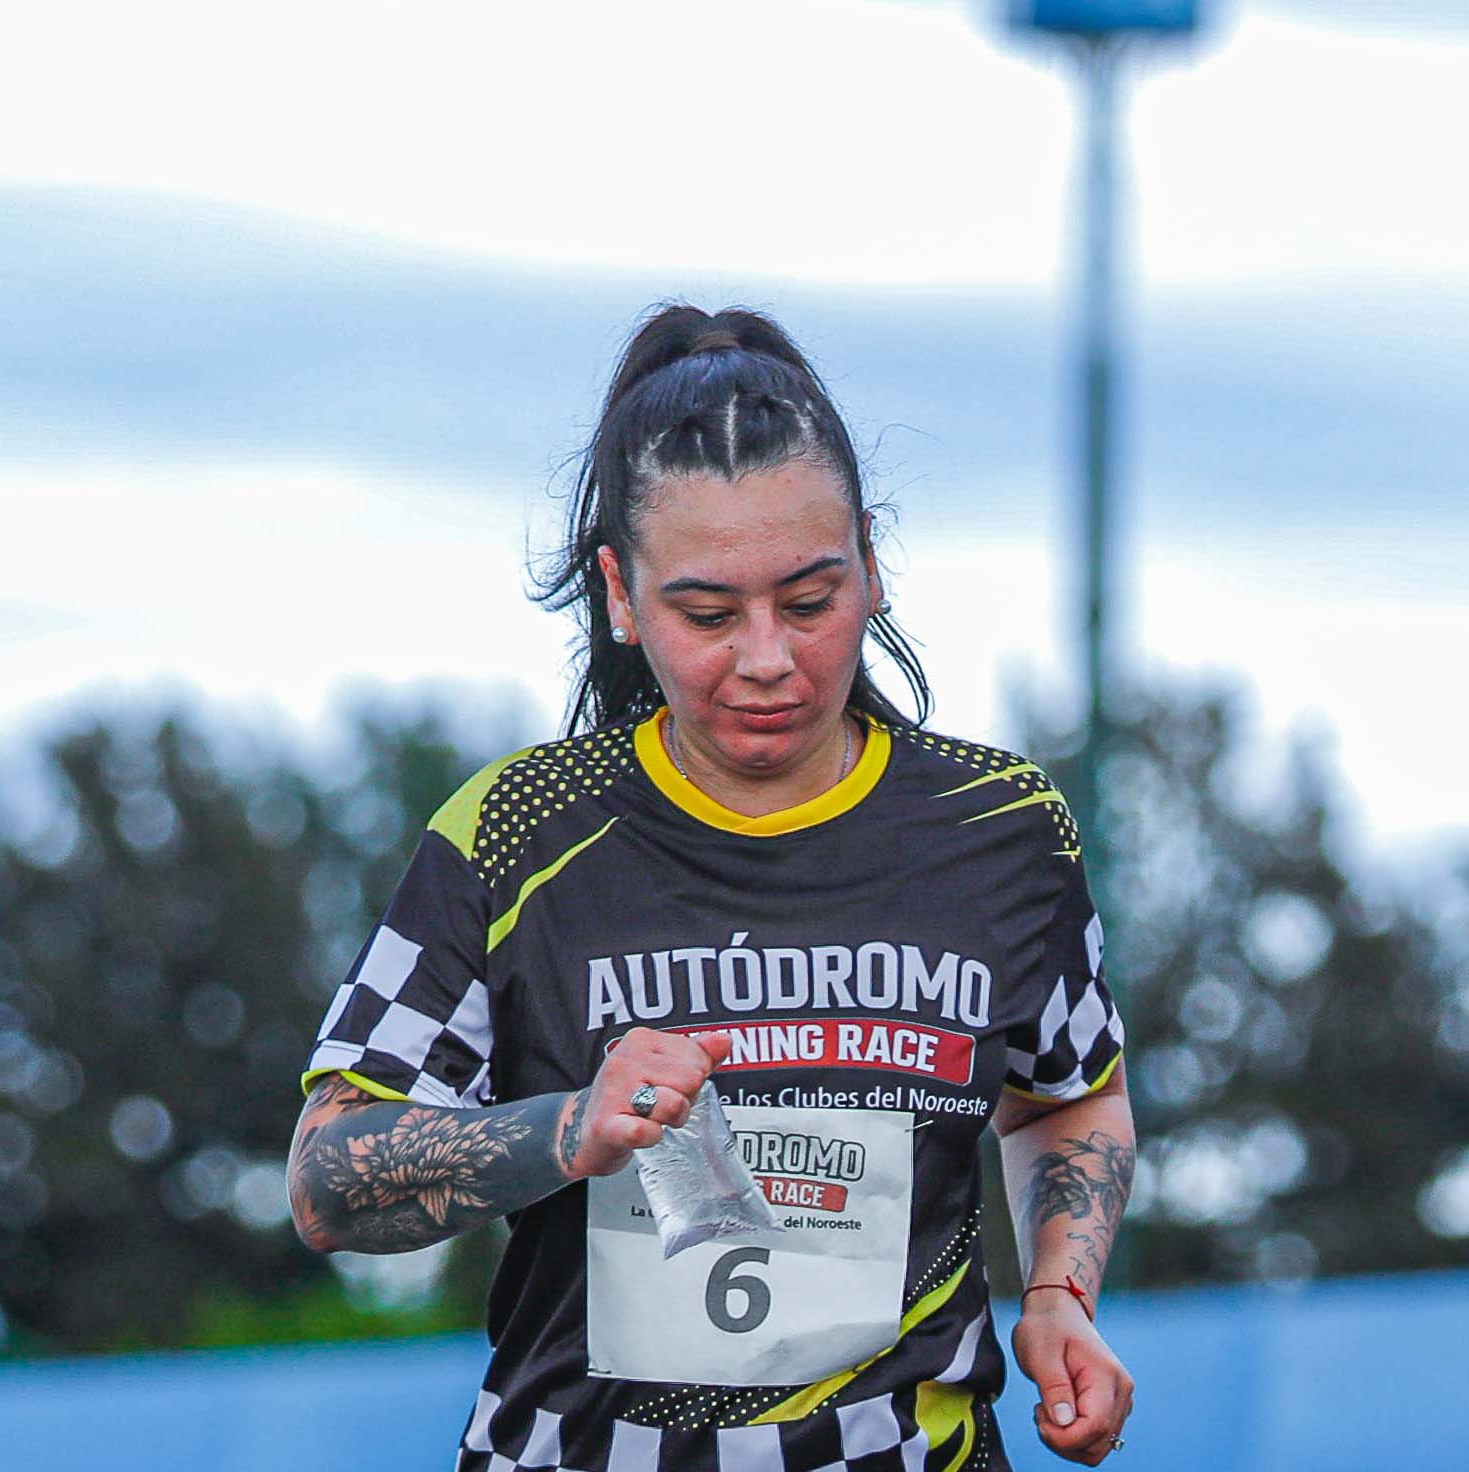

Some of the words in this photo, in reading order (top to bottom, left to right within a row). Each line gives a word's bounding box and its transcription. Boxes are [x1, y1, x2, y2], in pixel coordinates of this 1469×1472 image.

[585, 930, 993, 1032] AUTÓDROMO
[690, 1023, 826, 1066] NING
[836, 1023, 940, 1073] RACE
[738, 1088, 772, 1107] los
[778, 1086, 859, 1108] Clubes
[865, 1086, 902, 1109] del
[908, 1087, 988, 1117] Noroeste
[730, 1129, 866, 1182] DROMO
[630, 1204, 646, 1217] La
[783, 1215, 804, 1229] del
[809, 1216, 862, 1231] Noroeste
[769, 1178, 827, 1208] RACE
[704, 1246, 772, 1334] 6
